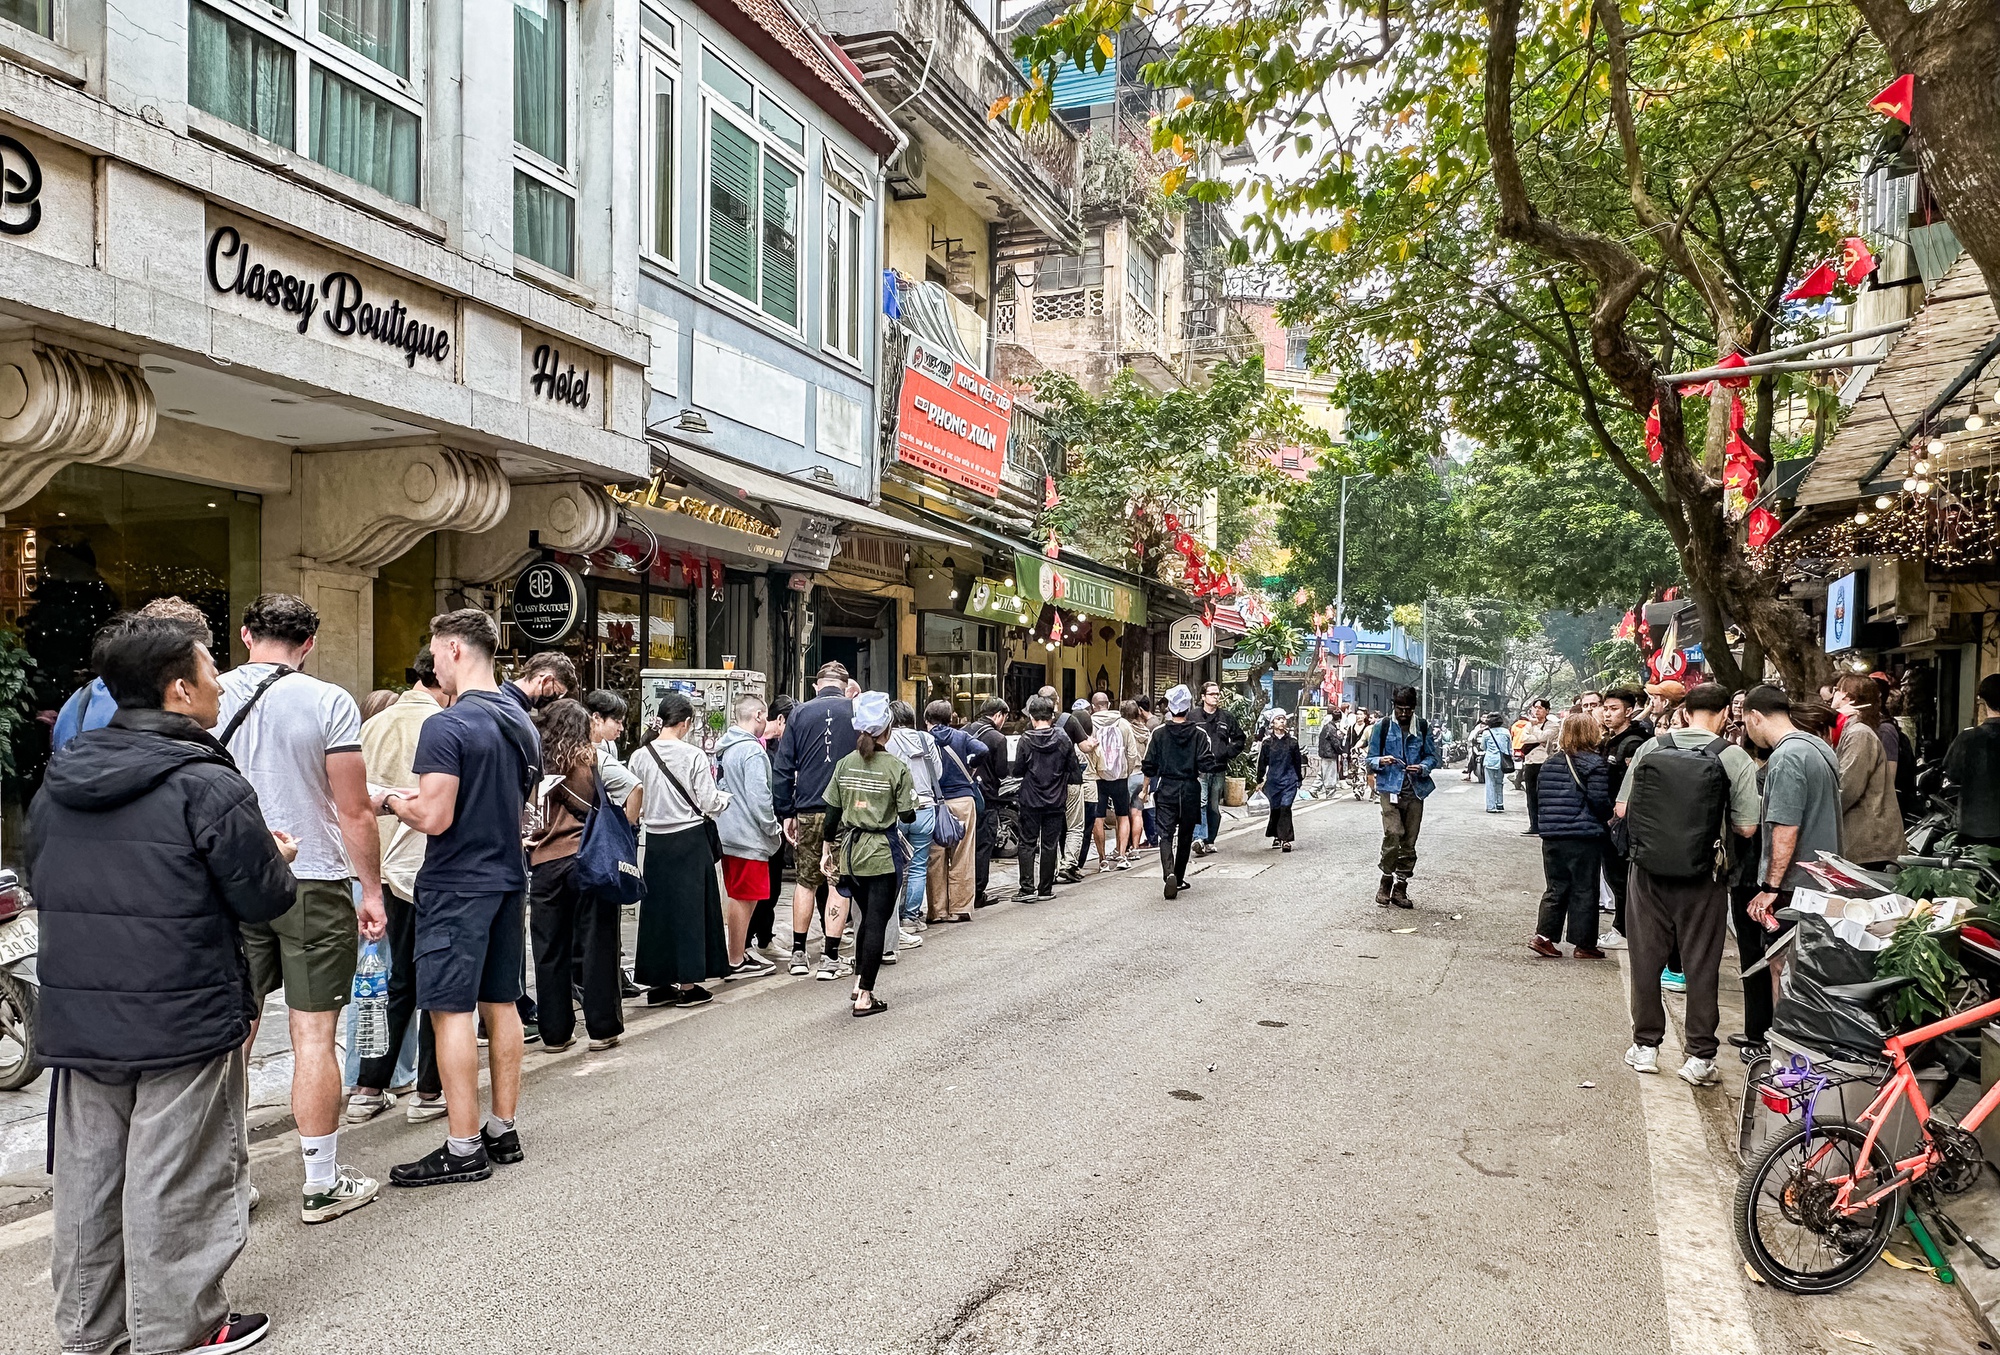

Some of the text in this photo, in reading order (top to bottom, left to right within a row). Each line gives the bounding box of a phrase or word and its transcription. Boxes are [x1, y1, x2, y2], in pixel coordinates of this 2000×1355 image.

[206, 226, 591, 410] Classy Boutique Hotel
[927, 401, 968, 437] PHONG
[967, 422, 997, 452] XUÂN
[515, 602, 538, 613] CLASSY
[1064, 578, 1096, 606] BANH
[1101, 588, 1115, 610] MI
[1180, 633, 1202, 641] BANH
[824, 708, 832, 763] ITALIA
